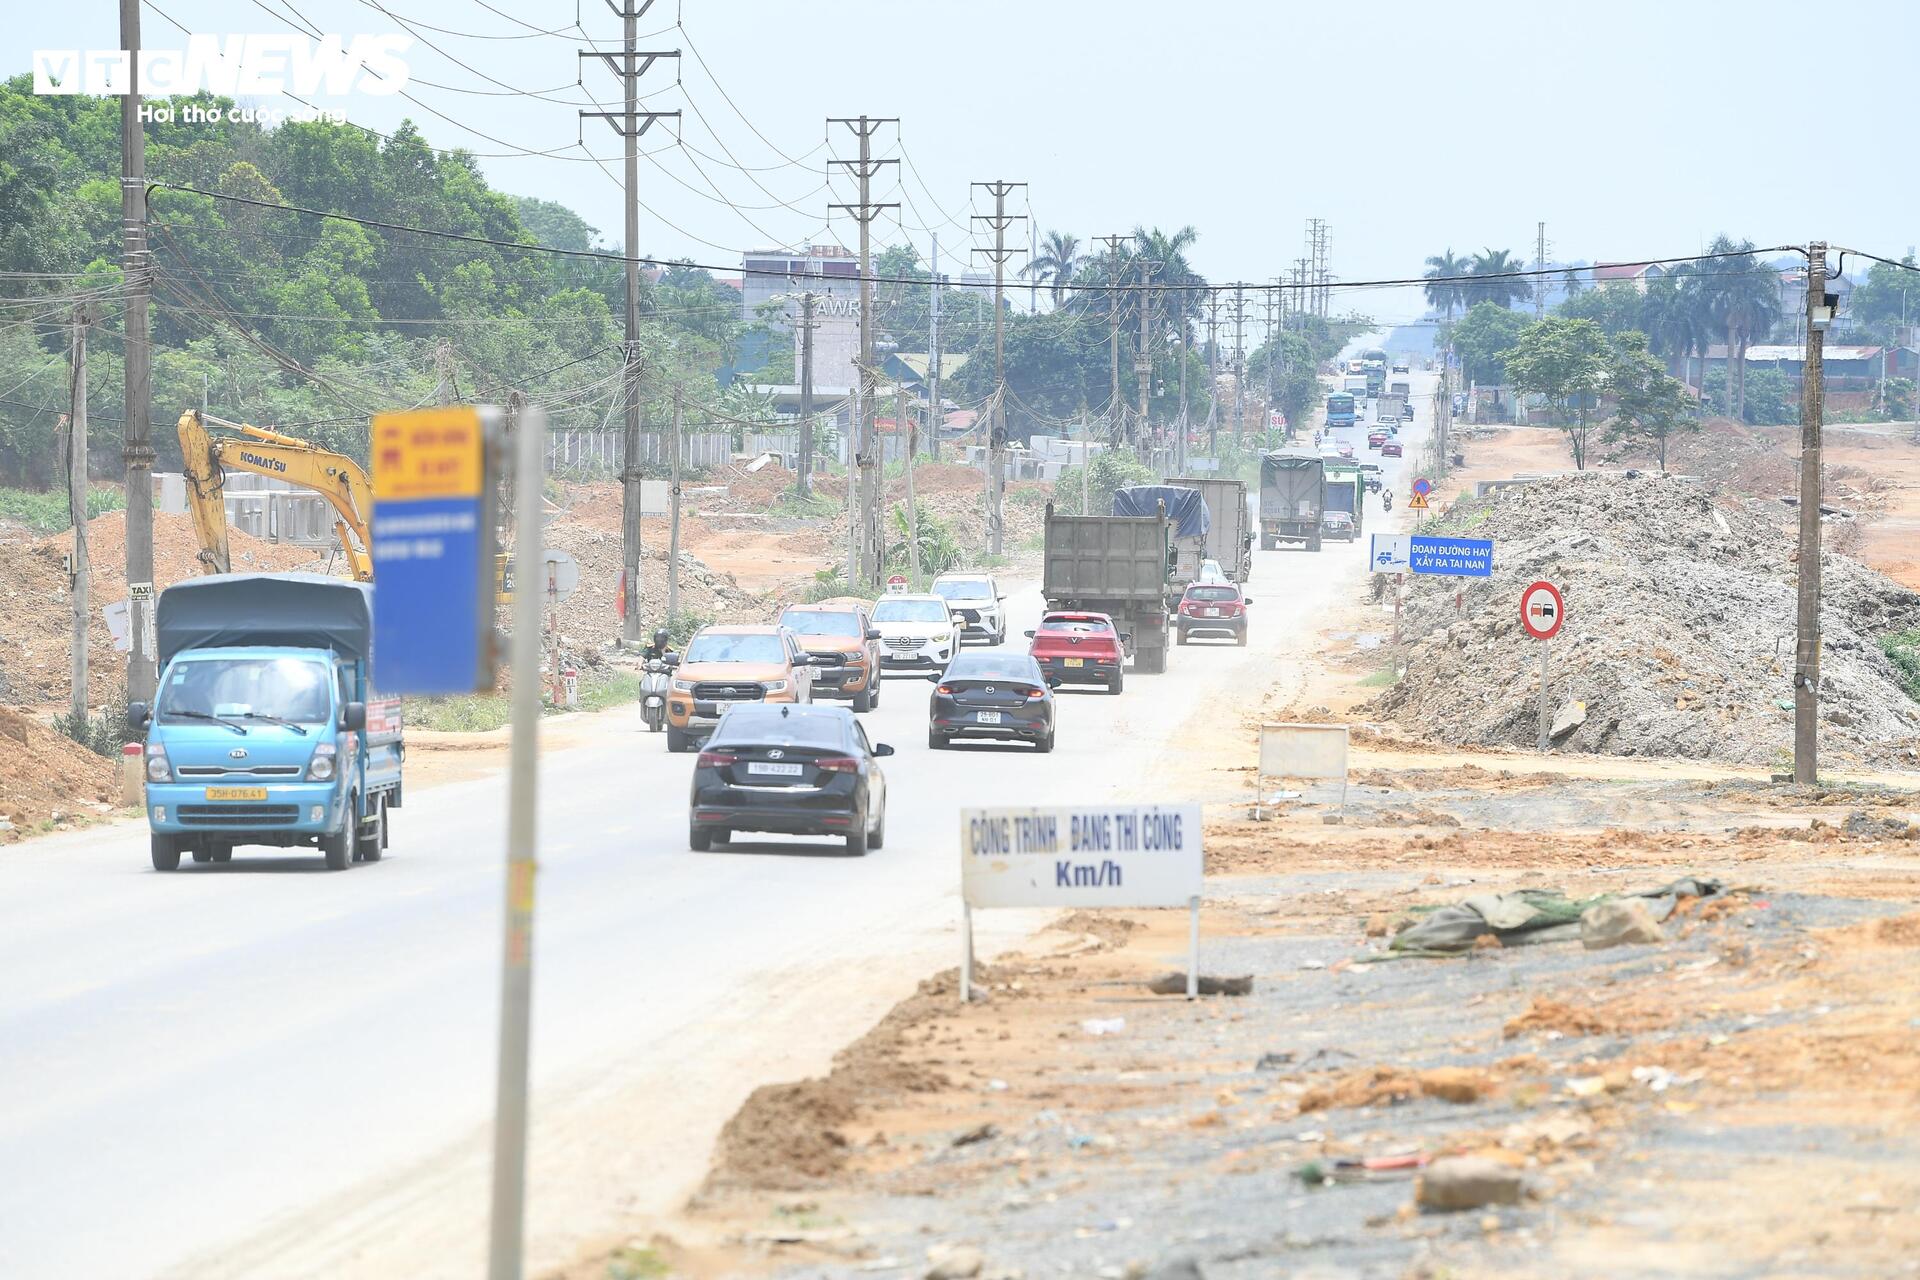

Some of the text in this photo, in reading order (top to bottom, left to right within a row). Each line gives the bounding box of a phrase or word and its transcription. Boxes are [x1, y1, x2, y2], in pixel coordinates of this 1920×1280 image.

[240, 451, 286, 472] KOMATSU
[1439, 544, 1471, 557] ĐƯỜNG
[1472, 547, 1491, 557] HAY
[1435, 558, 1448, 568] RA
[1449, 559, 1463, 569] TAI
[1464, 560, 1485, 572] NẠN
[131, 586, 152, 594] TAXI
[1056, 859, 1122, 888] Km/h
